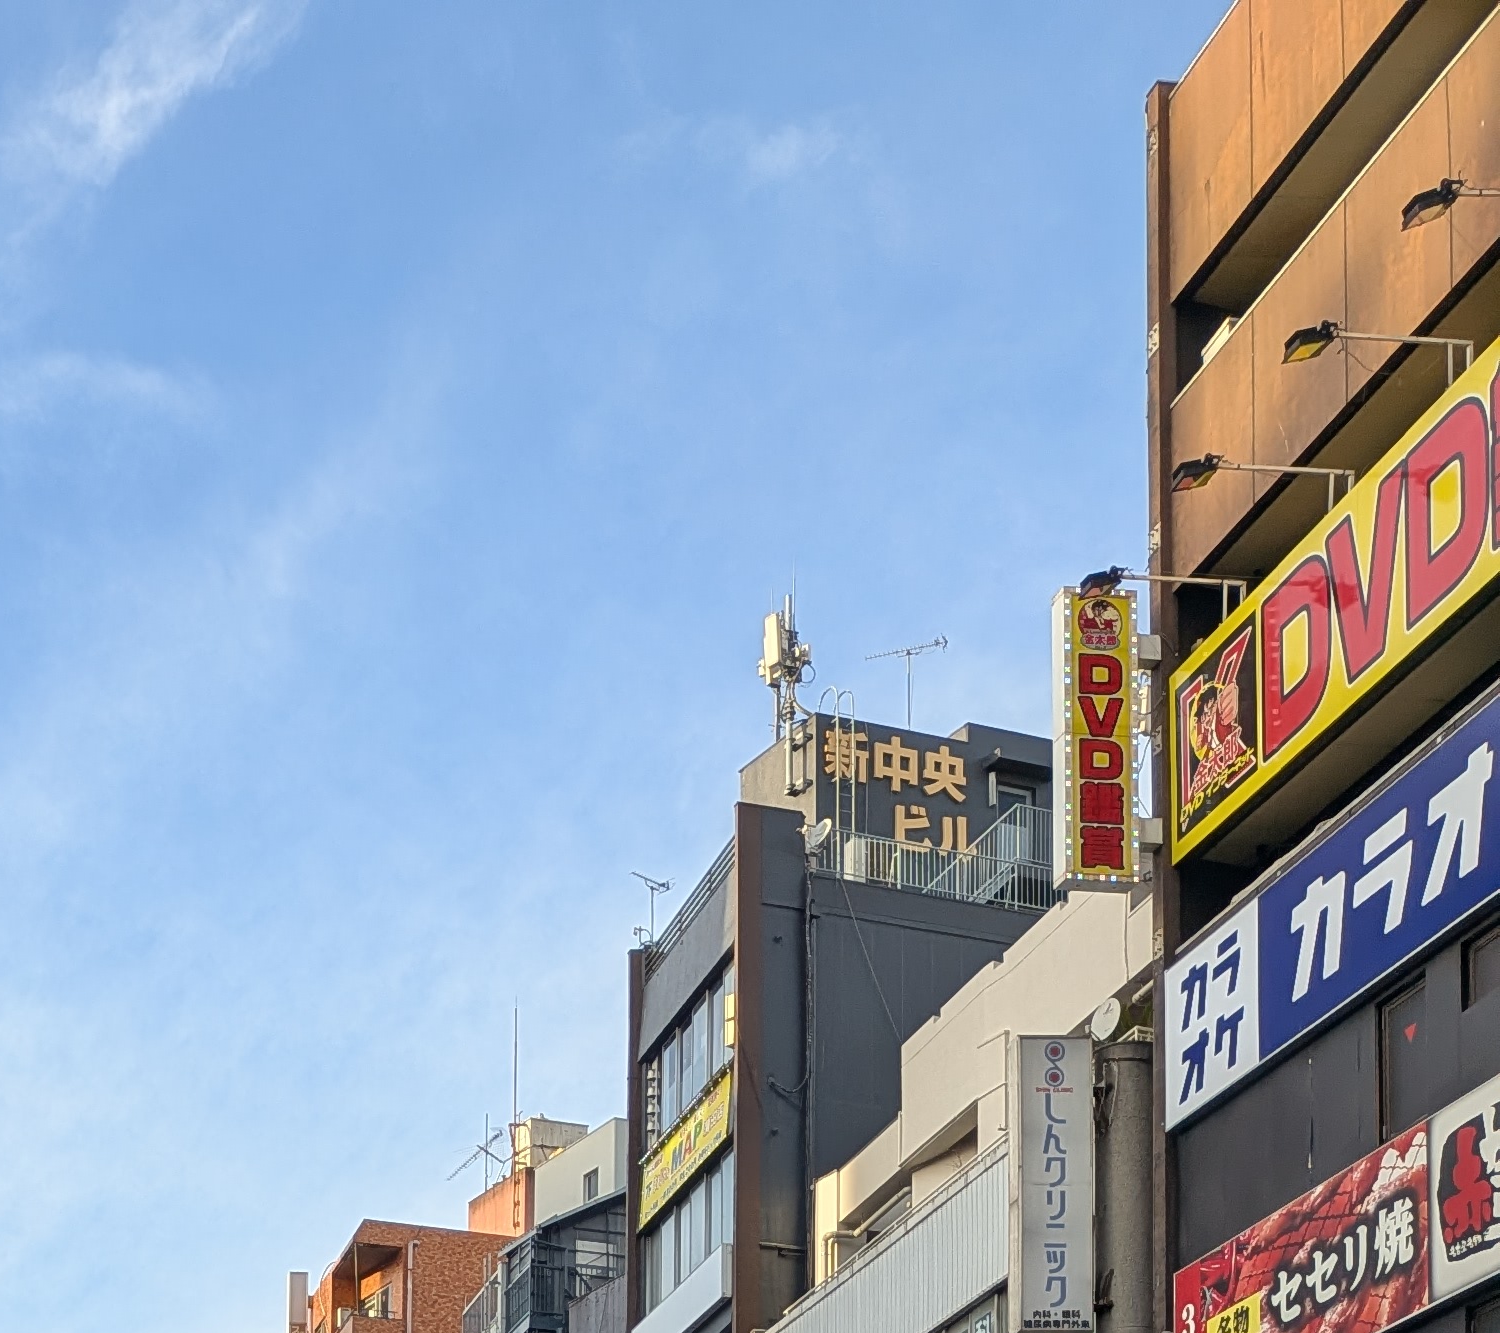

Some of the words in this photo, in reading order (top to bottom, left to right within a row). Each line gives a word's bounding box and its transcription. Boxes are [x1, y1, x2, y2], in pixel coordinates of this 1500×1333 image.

[1263, 396, 1487, 752] DVD
[824, 729, 968, 802] 新中央
[1043, 1093, 1067, 1308] しんクリニック
[1271, 1198, 1414, 1326] セセリ焼
